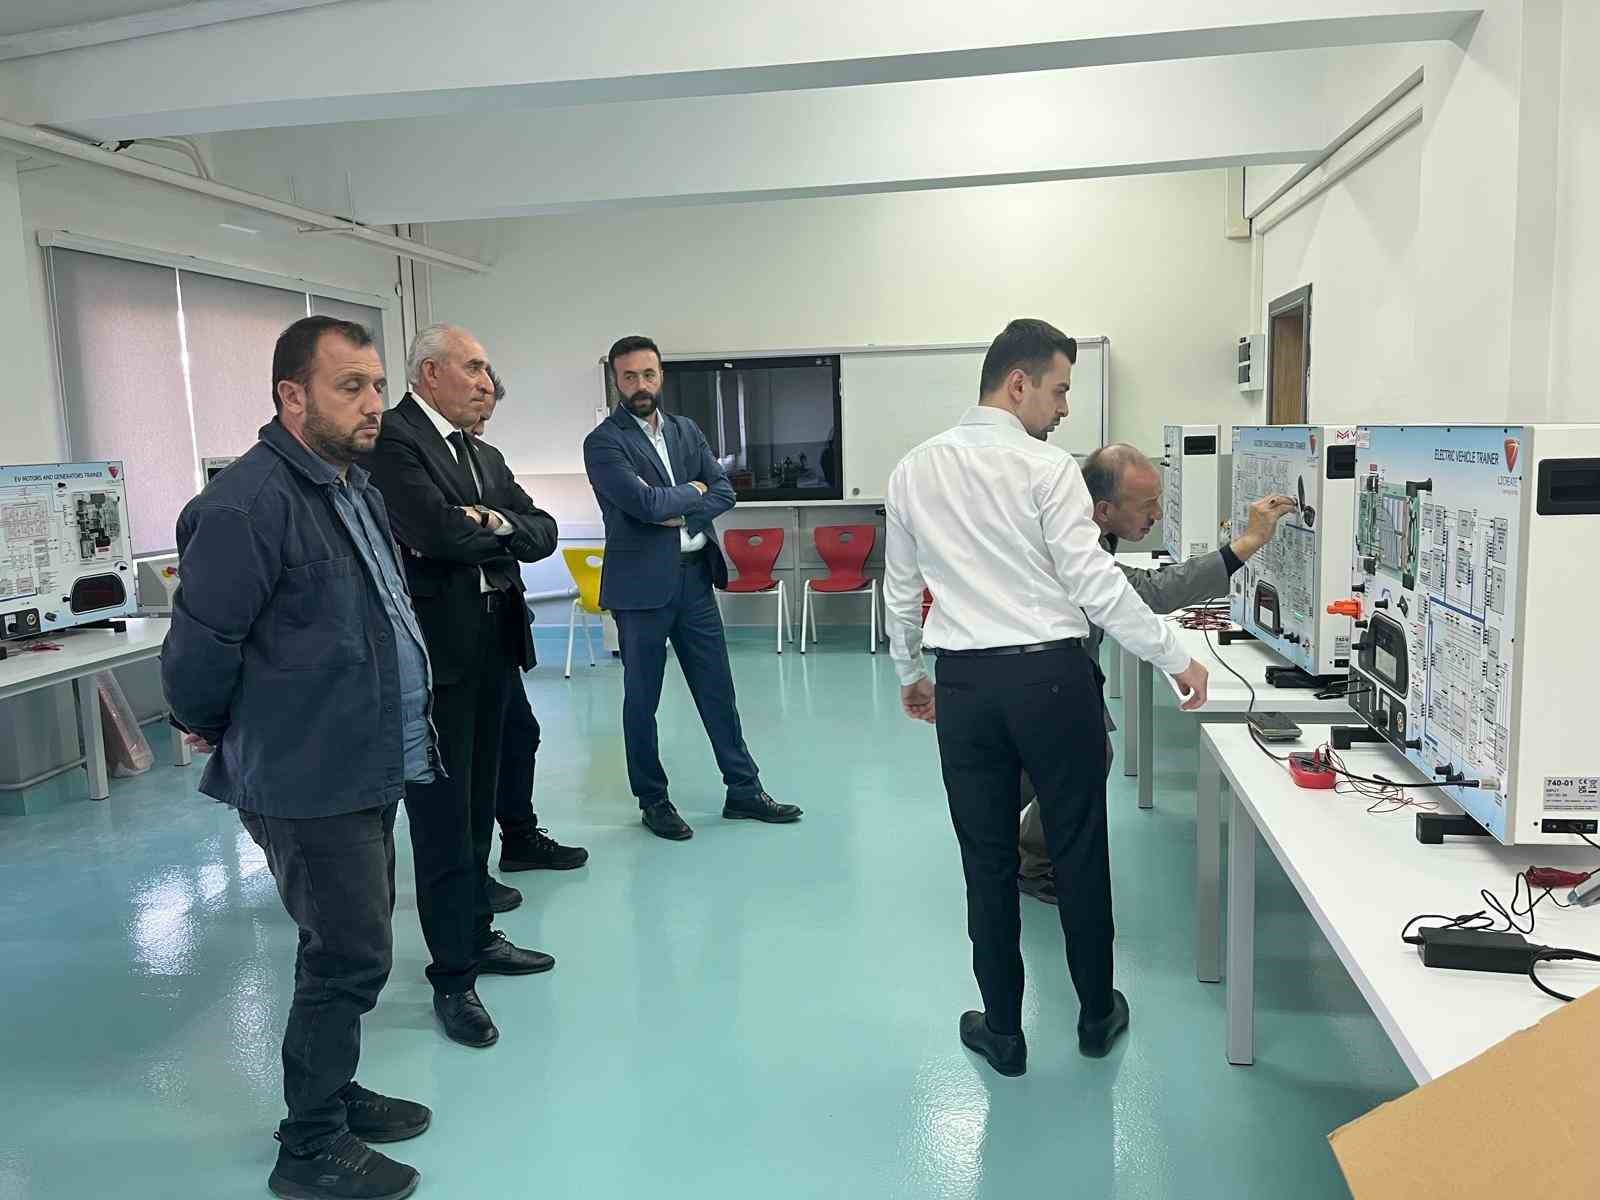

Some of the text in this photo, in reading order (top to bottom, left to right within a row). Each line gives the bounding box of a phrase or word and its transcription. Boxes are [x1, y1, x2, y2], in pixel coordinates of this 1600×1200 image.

[1434, 448, 1499, 465] ELECTRIC VEHICLE TRAINER
[54, 472, 83, 480] GENERATORS
